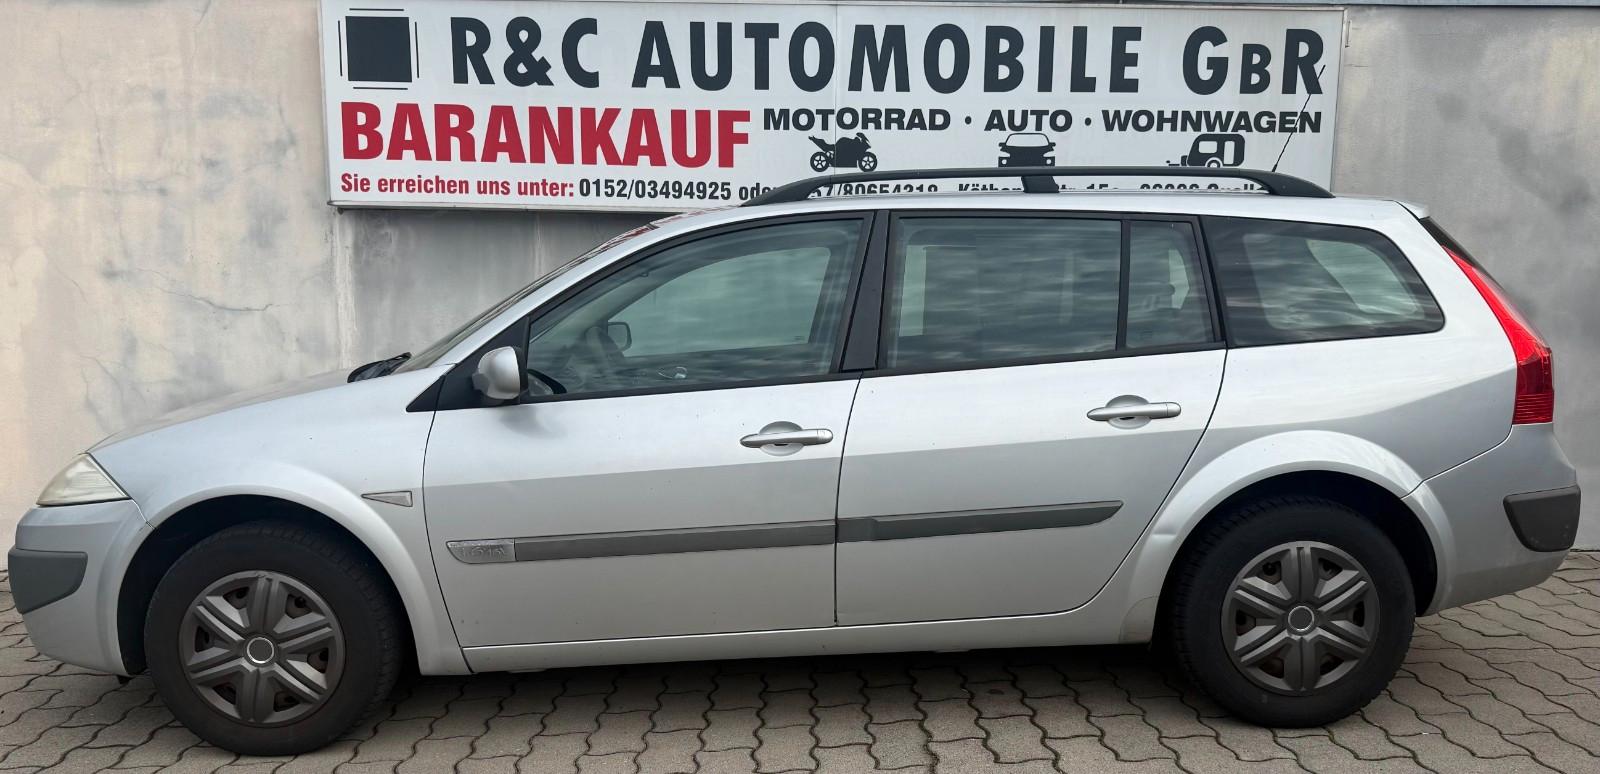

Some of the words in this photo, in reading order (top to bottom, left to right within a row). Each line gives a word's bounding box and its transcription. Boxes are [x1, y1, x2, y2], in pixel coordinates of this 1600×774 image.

[450, 16, 600, 88] R&C
[631, 20, 1143, 94] AUTOMOBILE
[340, 101, 751, 169] BARANKAUF
[763, 108, 951, 132] MOTORRAD
[983, 109, 1073, 132] AUTO
[1101, 110, 1322, 134] WOHNWAGEN
[341, 173, 371, 193] Sie
[377, 175, 470, 194] erreichen
[476, 180, 511, 196] uns
[517, 178, 574, 197] unter:
[579, 178, 732, 200] 0152/03494925
[738, 182, 777, 201] od
